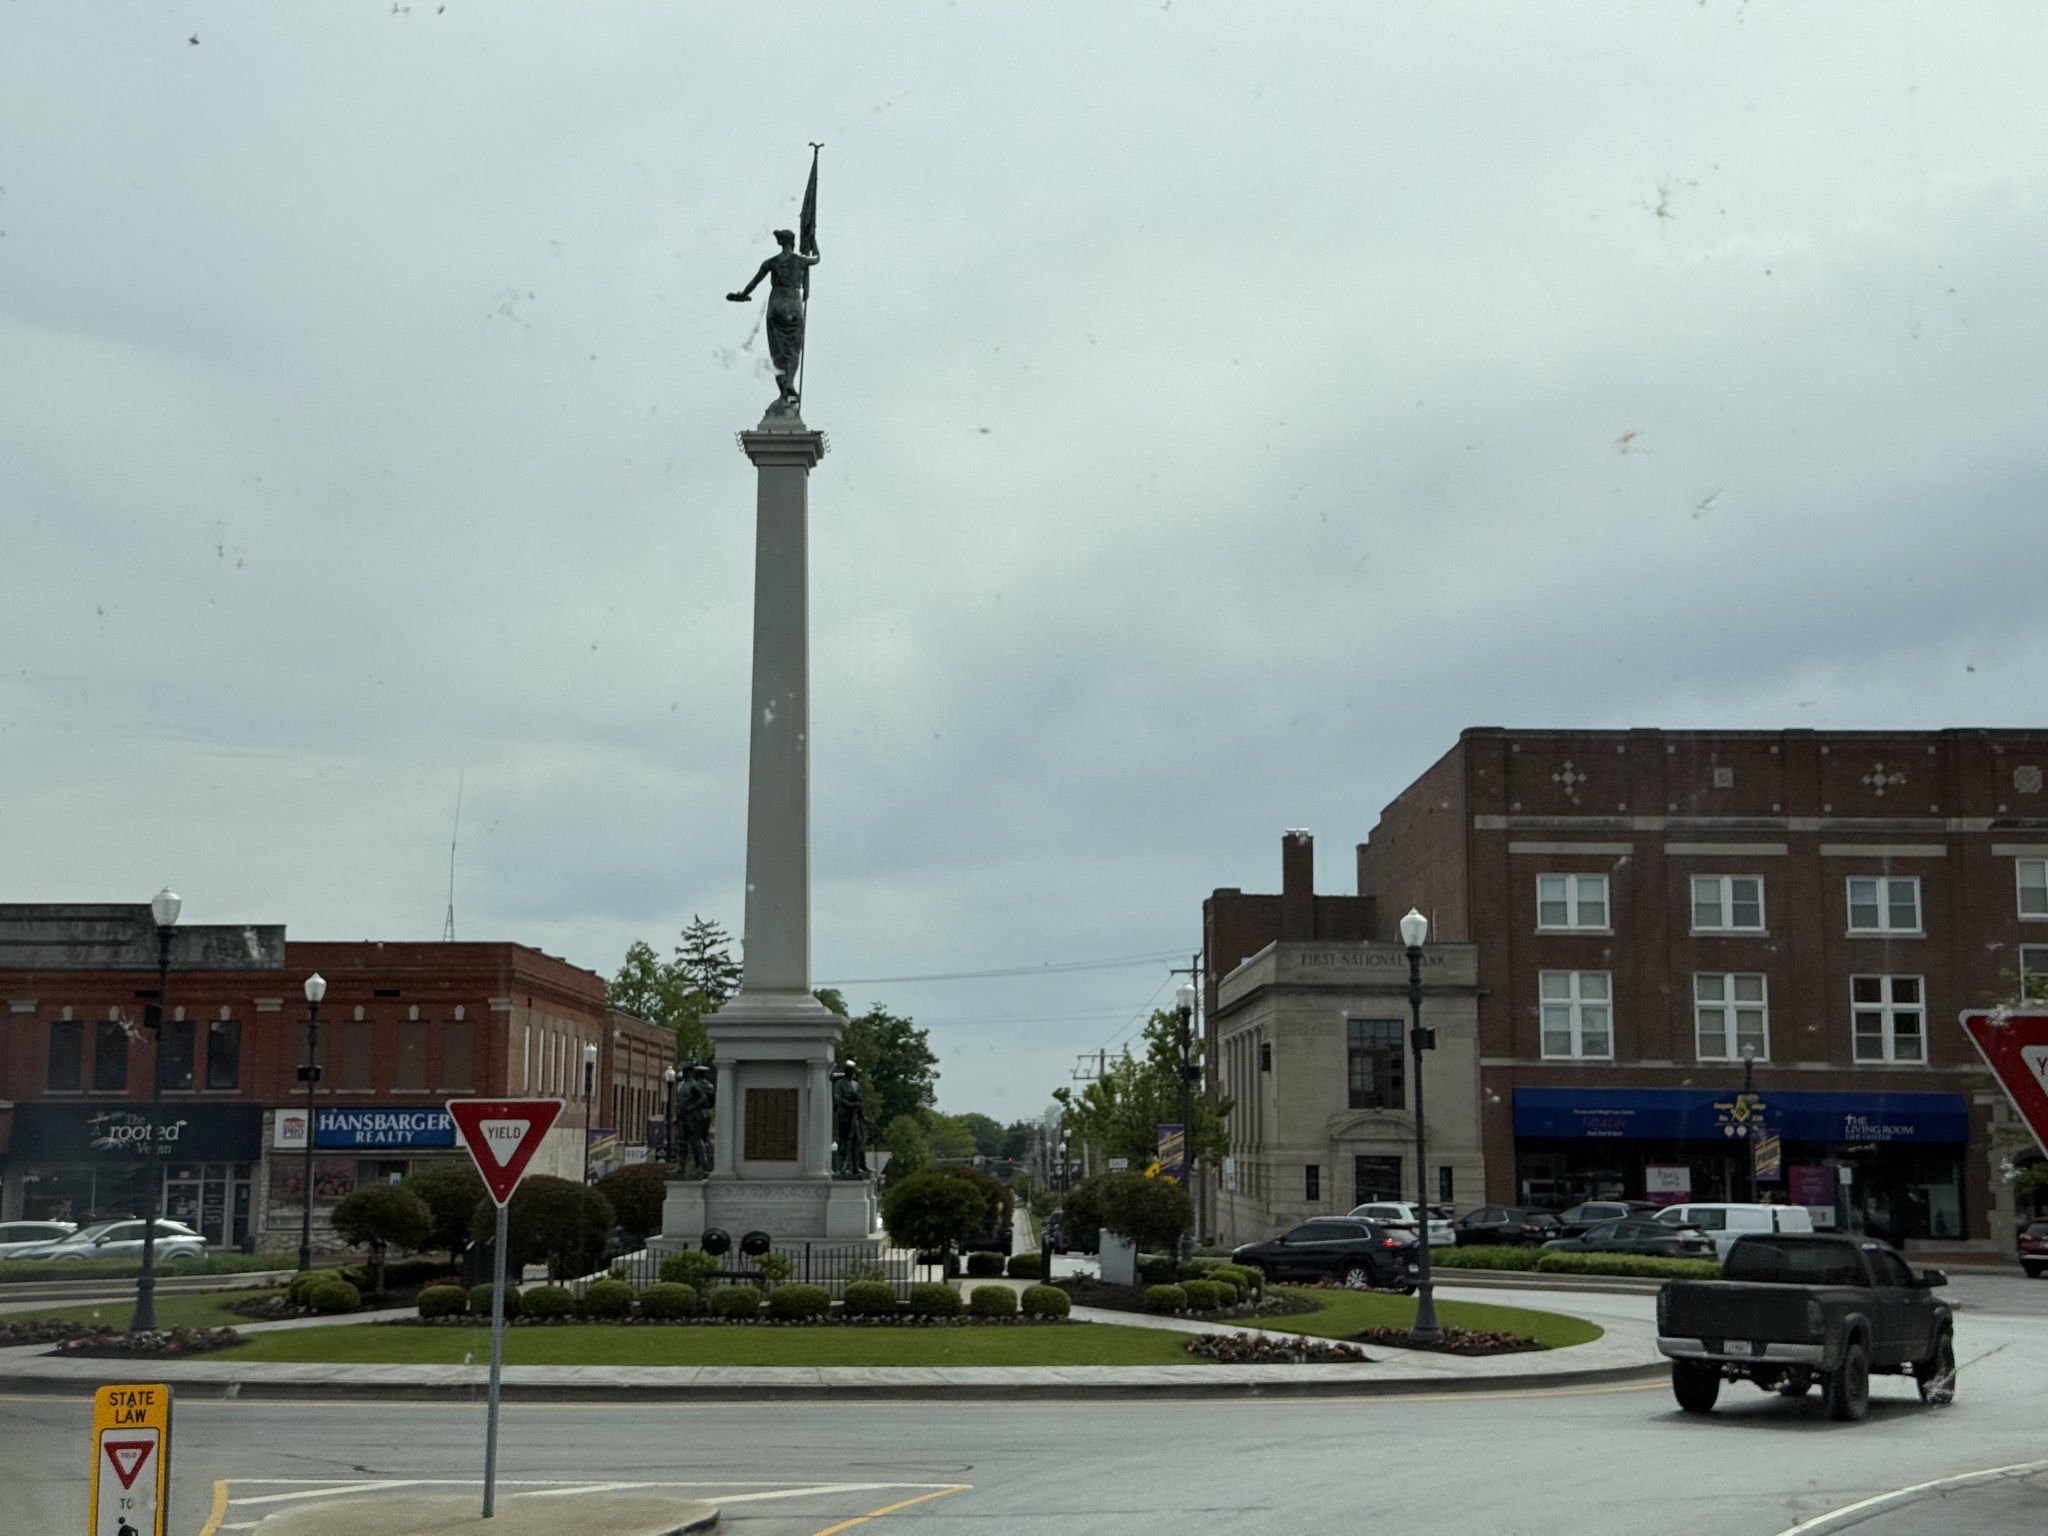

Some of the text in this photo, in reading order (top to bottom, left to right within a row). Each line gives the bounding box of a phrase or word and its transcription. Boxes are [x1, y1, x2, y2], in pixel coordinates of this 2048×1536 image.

[1301, 953, 1448, 967] FIRST NATIONAL ANK
[126, 1113, 146, 1125] The
[318, 1112, 451, 1131] HANSBARGER
[109, 1120, 182, 1141] rooted
[355, 1130, 415, 1143] REALTY
[487, 1125, 521, 1139] YIELD
[1845, 1124, 1915, 1135] LIVING ROOM
[136, 1141, 172, 1155] Vean
[109, 1391, 155, 1407] STATE
[115, 1408, 147, 1424] LAW
